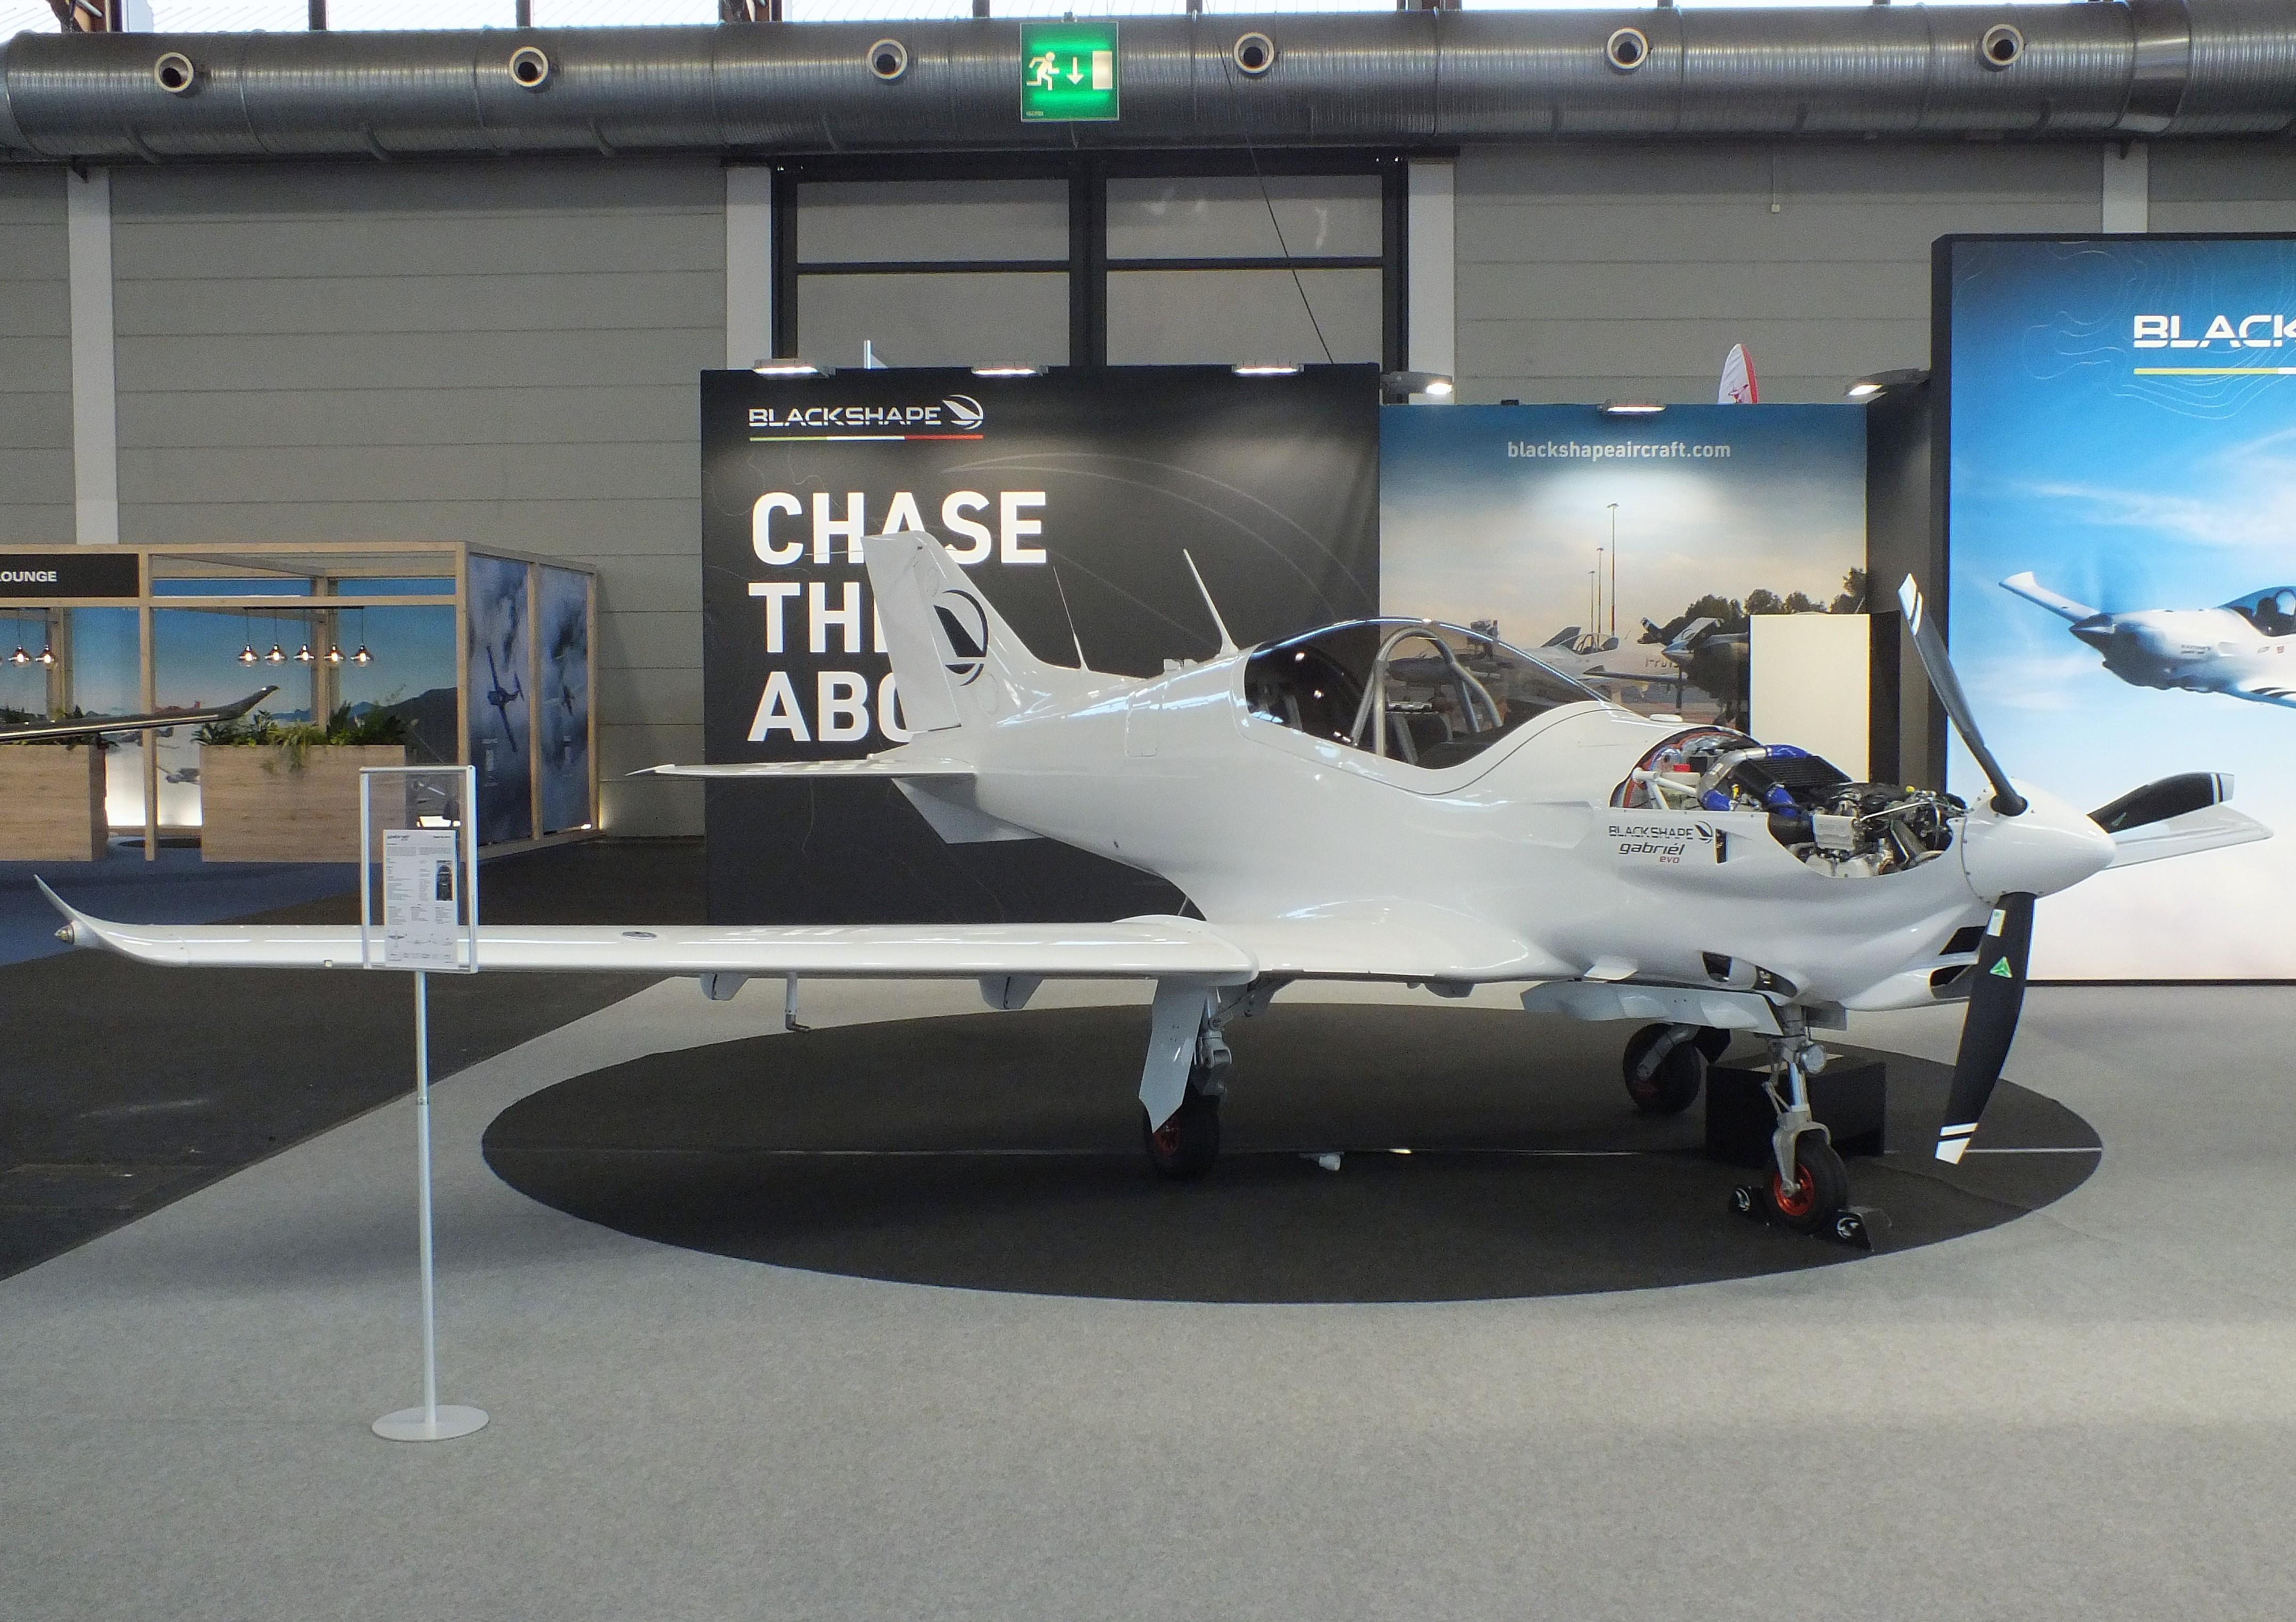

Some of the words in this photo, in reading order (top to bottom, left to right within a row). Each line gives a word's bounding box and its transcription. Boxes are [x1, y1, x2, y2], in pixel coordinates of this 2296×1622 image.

[748, 407, 941, 427] BLACKSHAPE
[1508, 441, 1731, 462] blackshapeaircraft.com
[0, 571, 57, 582] OUNGE
[1608, 826, 1694, 840] BLACKSHAPE
[1618, 842, 1686, 855] gabriél
